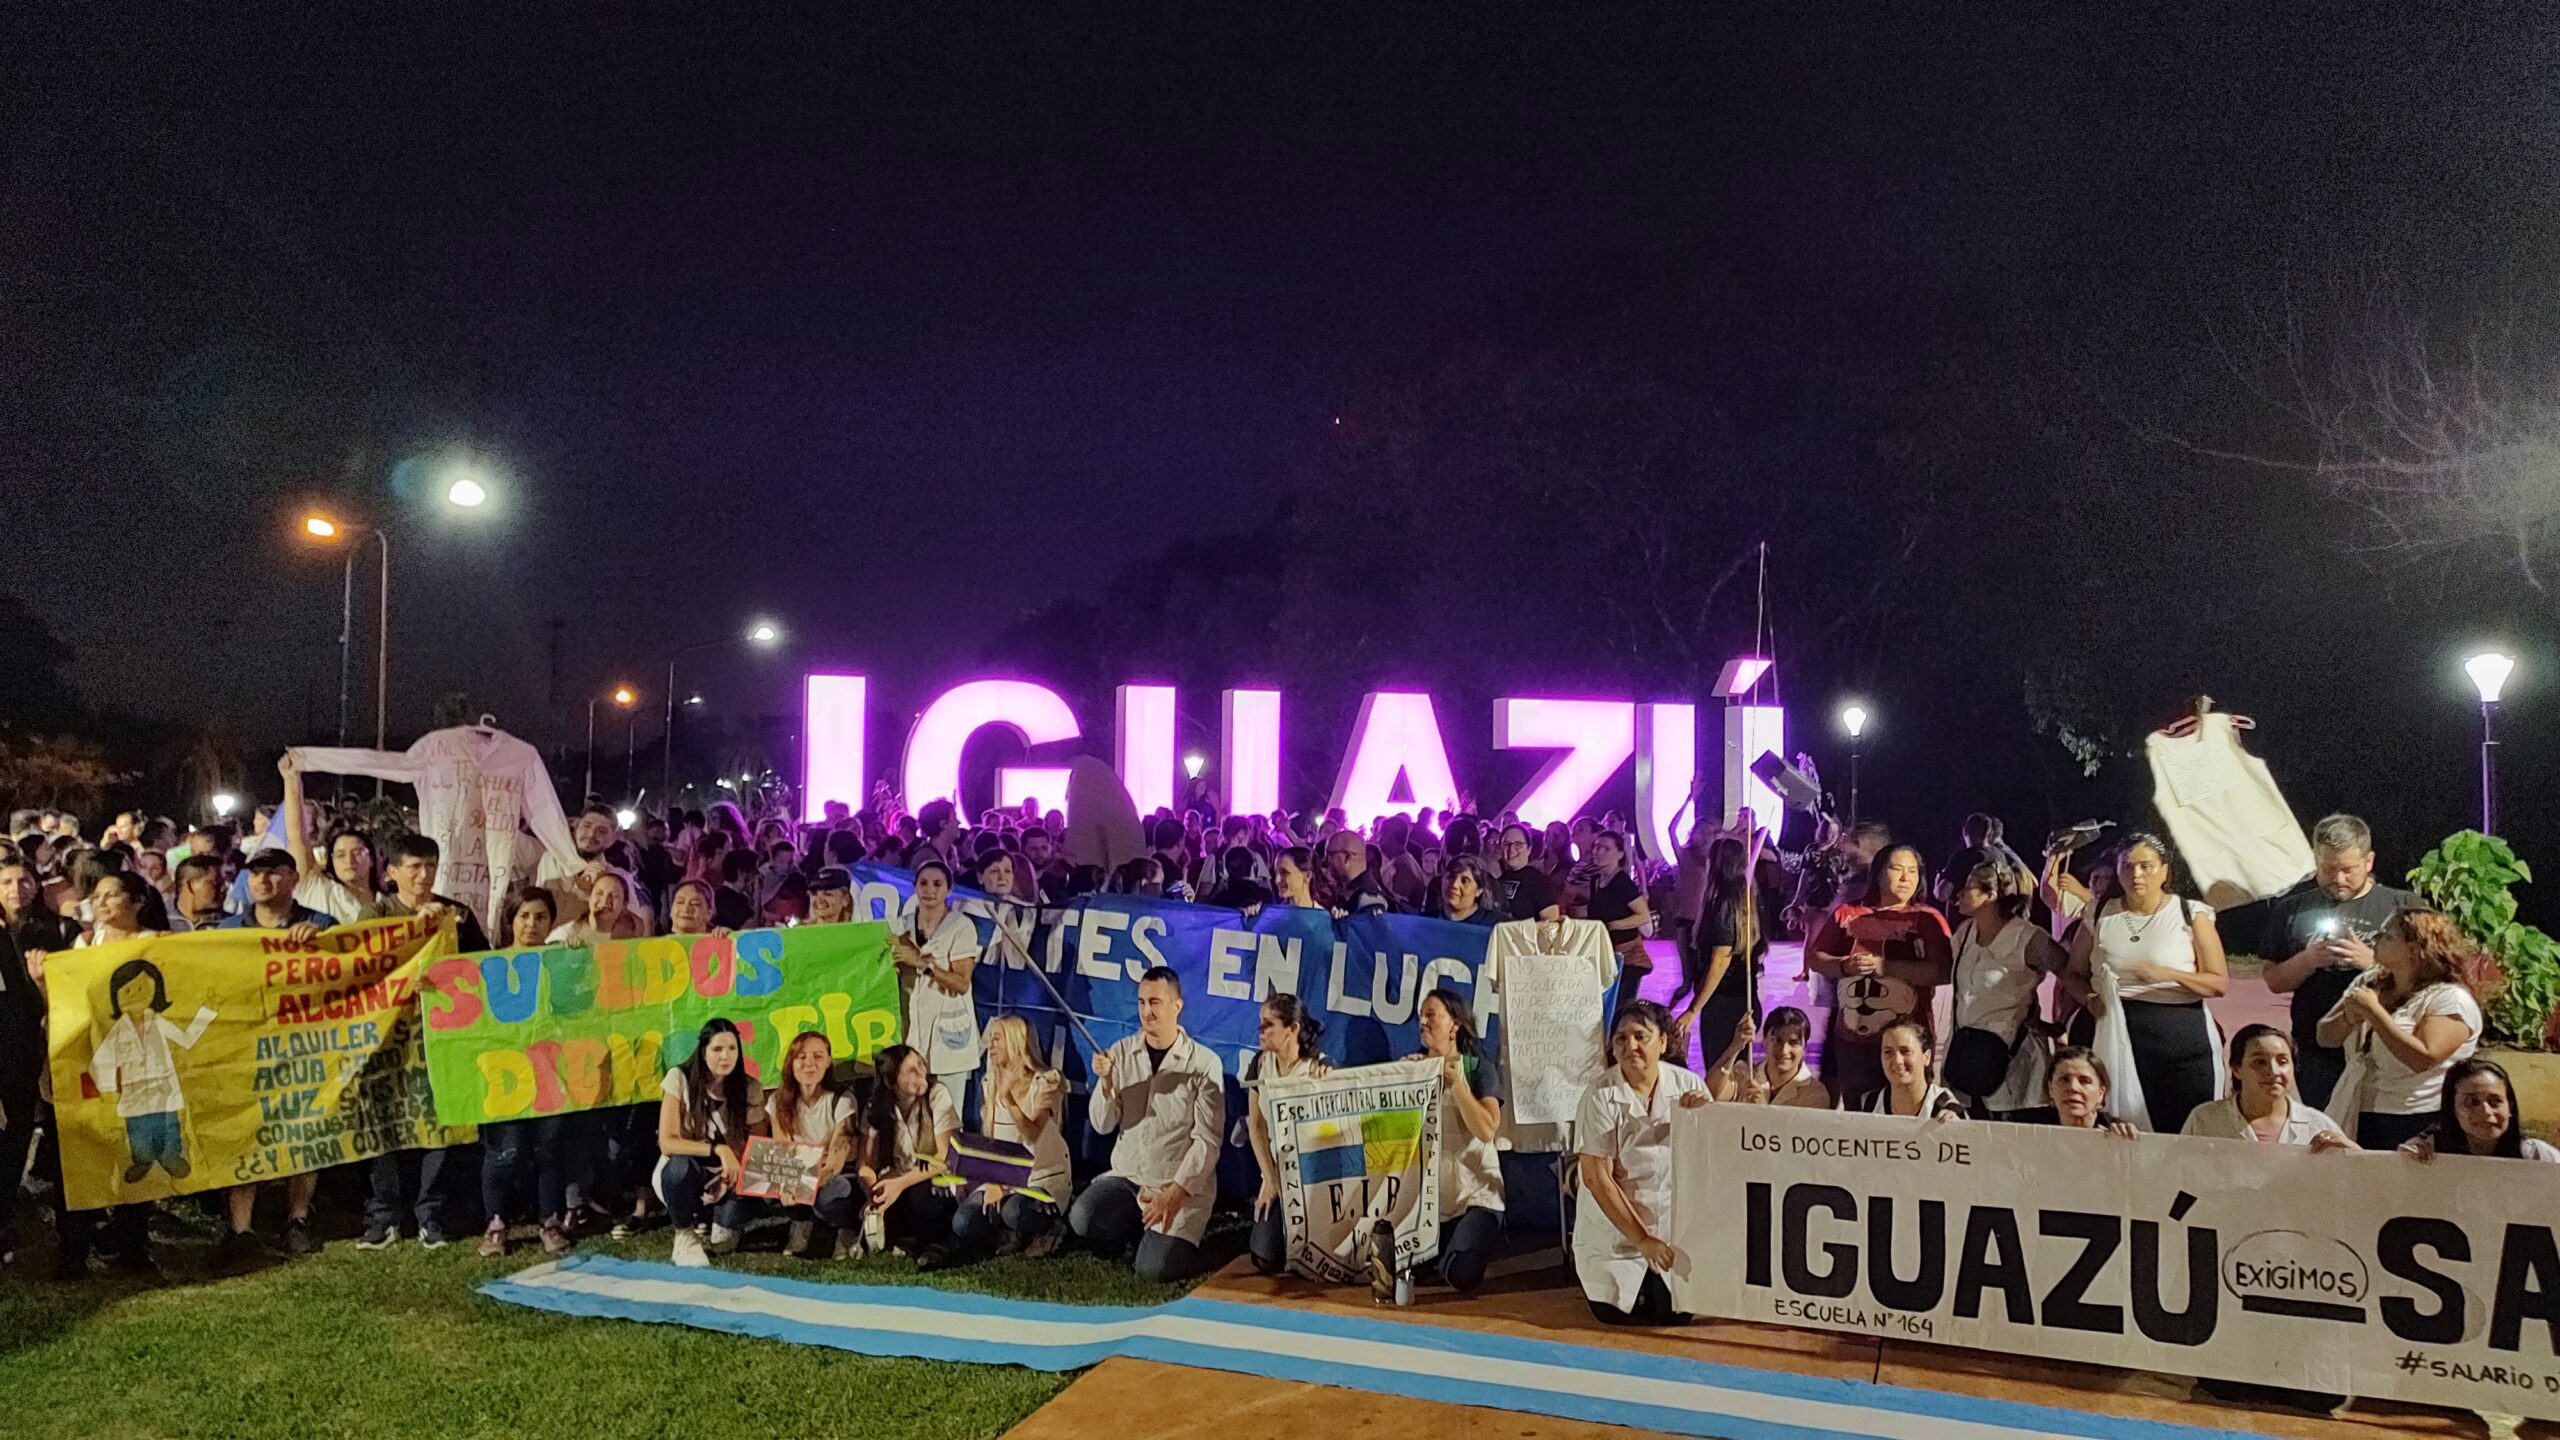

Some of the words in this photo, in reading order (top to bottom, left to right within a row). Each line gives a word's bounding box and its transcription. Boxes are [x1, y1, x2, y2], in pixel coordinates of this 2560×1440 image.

[801, 658, 1784, 867] IGUAZÚ
[265, 957, 342, 988] PERO
[353, 953, 398, 978] NO
[425, 931, 784, 1031] SUELDOS
[1207, 928, 1303, 1003] EN
[1509, 959, 1535, 976] NO
[1543, 960, 1569, 975] SOY
[1574, 961, 1593, 976] DE
[1509, 978, 1584, 993] IZQUIERDA
[1510, 995, 1524, 1009] NI
[1529, 995, 1543, 1008] DE
[1549, 993, 1600, 1009] DERECHA
[1509, 1012, 1527, 1026] NO
[1532, 1009, 1594, 1025] RESPONDO
[256, 1021, 379, 1061] ALQUILER
[1512, 1042, 1567, 1058] PARTIDO
[252, 1058, 327, 1092] AGUA
[259, 1087, 325, 1123] LUZ
[1311, 1088, 1376, 1119] INTERCULTURAL
[288, 1138, 345, 1171] PARA
[1792, 1135, 1922, 1161] DOCENTES
[1937, 1142, 1972, 1165] DE
[1280, 1126, 1305, 1245] JORNADA
[1746, 1182, 2219, 1347] IGUAZÚ
[1774, 1298, 1867, 1328] ESCUELA
[1897, 1315, 1933, 1338] 164
